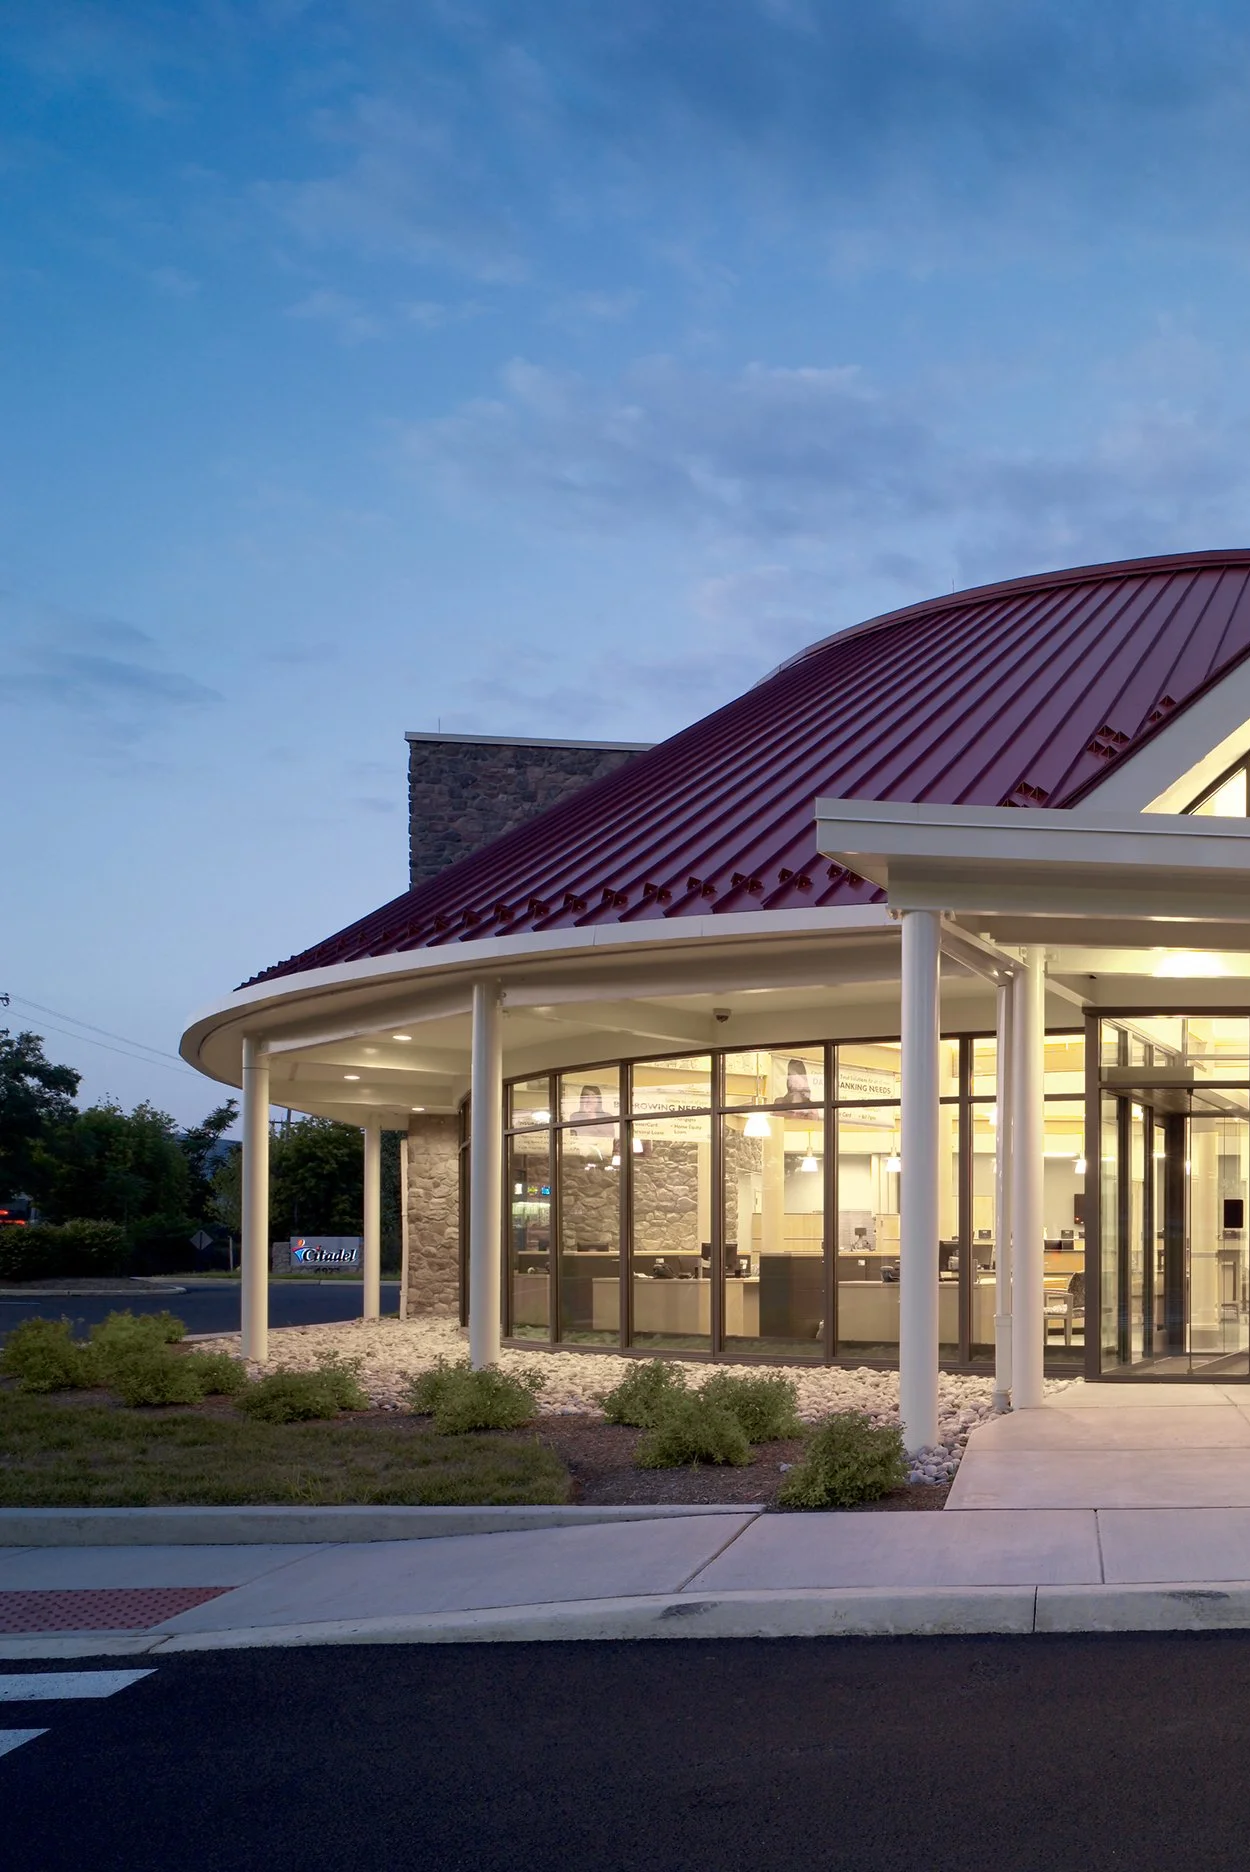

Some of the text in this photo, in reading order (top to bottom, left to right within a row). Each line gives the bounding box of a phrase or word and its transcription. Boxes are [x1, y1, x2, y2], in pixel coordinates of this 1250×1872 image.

[838, 1082, 867, 1092] ANKING
[869, 1085, 891, 1095] NEEDS
[302, 1247, 358, 1263] Citadel
